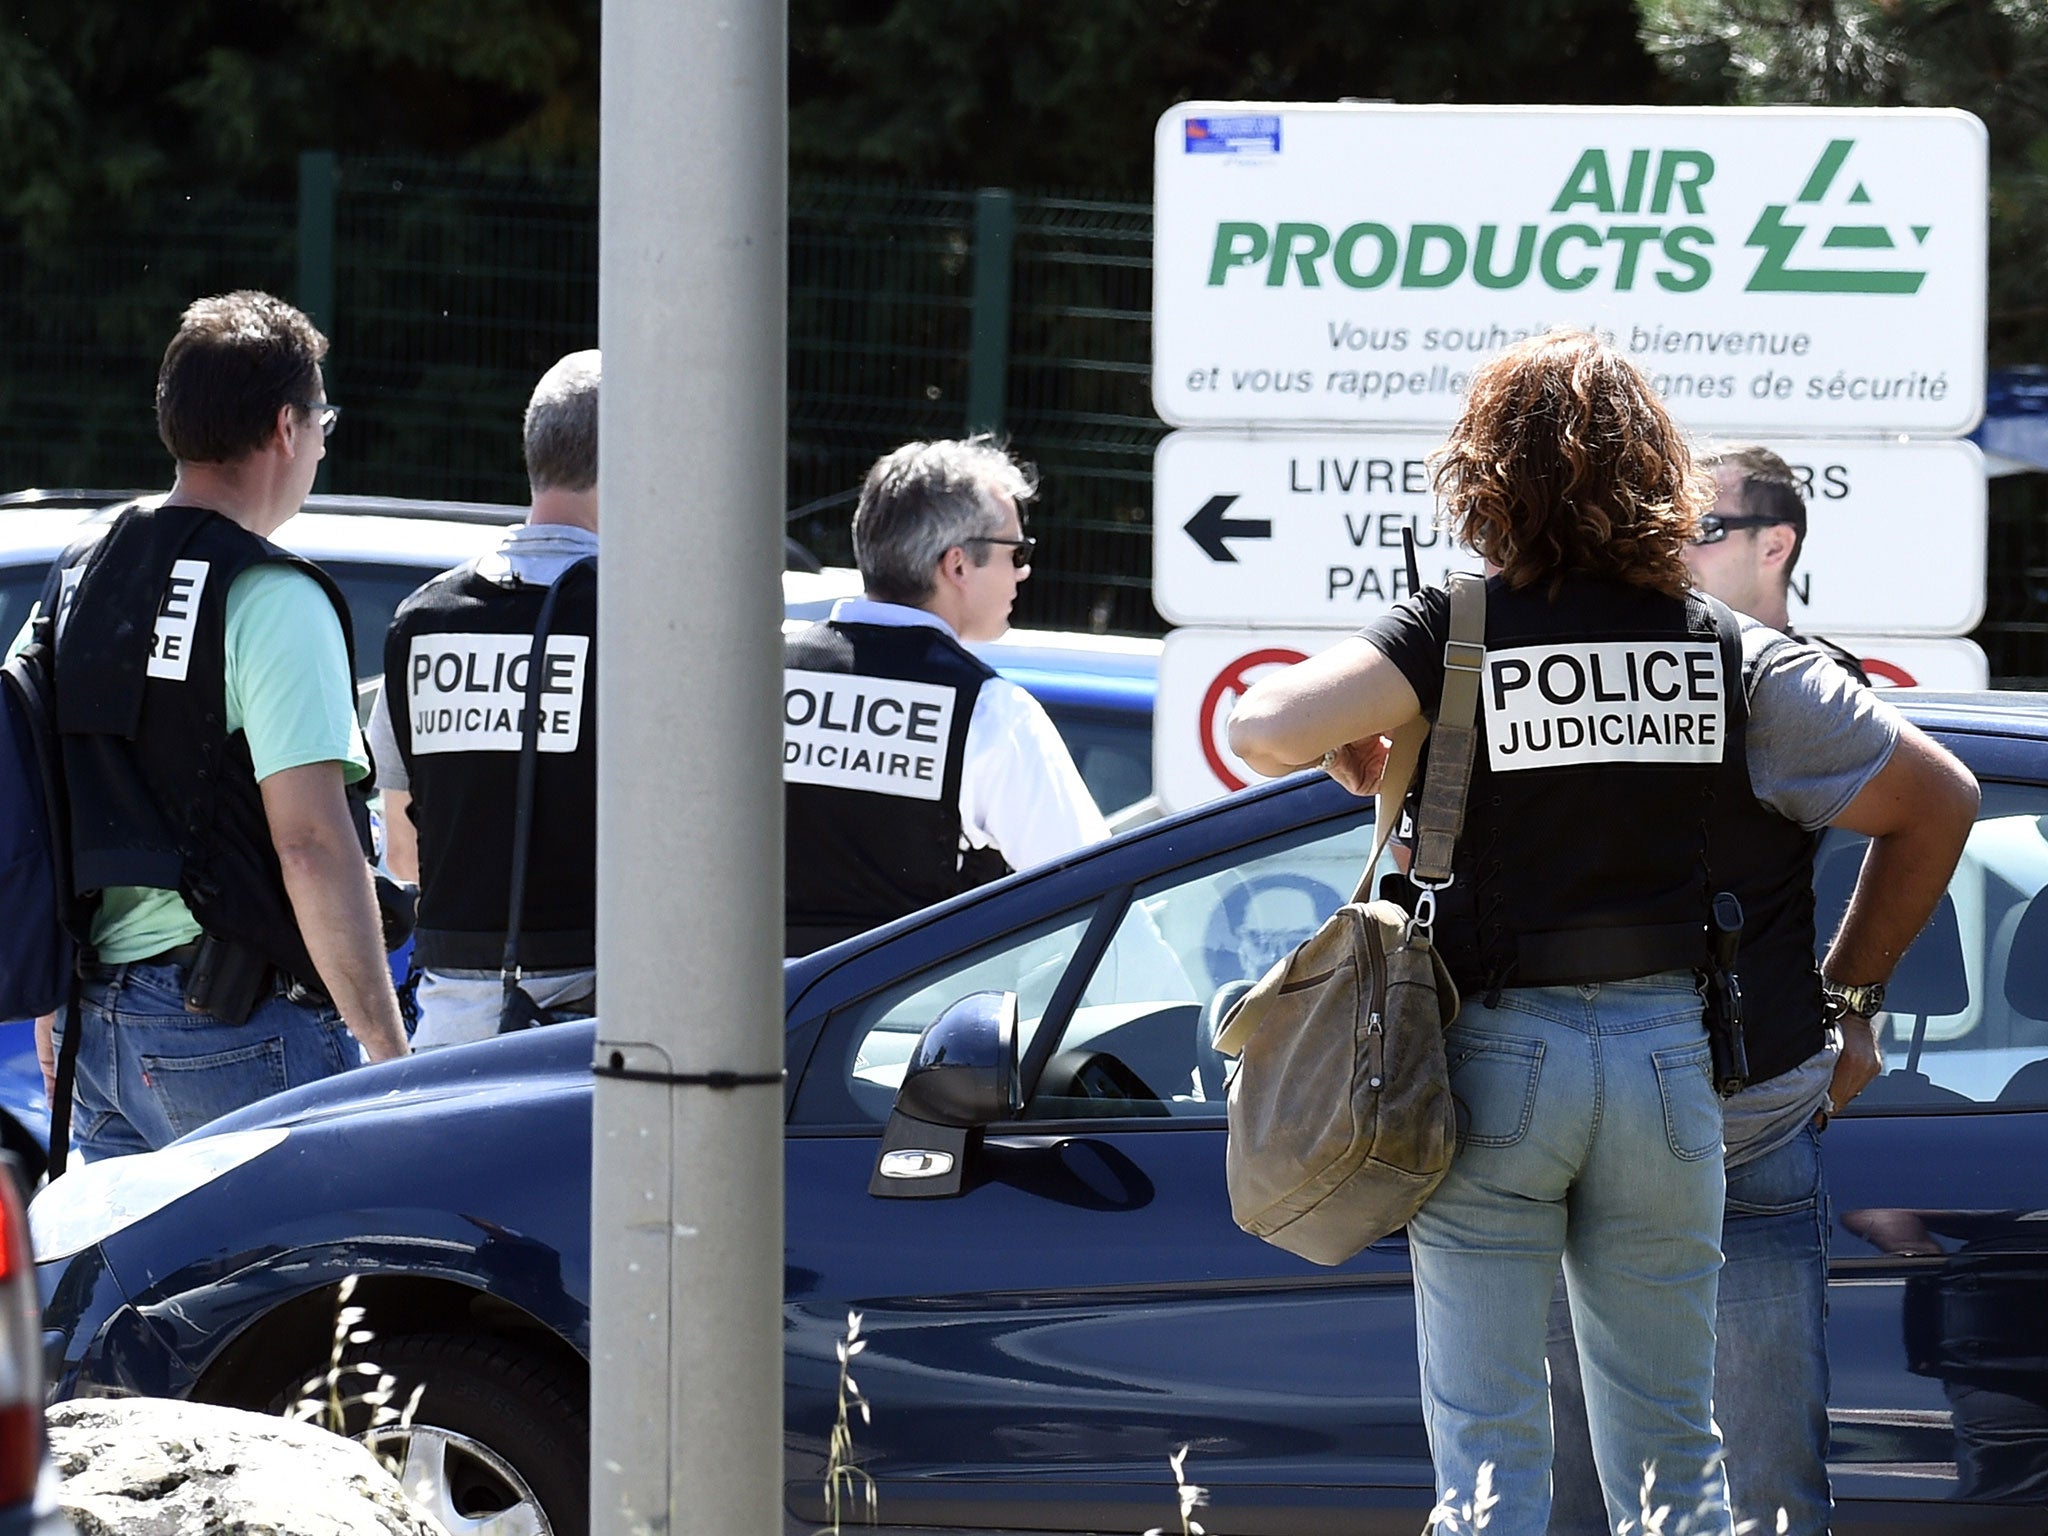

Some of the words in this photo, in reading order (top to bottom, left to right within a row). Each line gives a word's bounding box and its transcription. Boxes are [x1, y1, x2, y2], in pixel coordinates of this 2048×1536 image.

[1550, 149, 1715, 214] AIR
[1207, 222, 1715, 293] PRODUCTS
[1327, 320, 1409, 351] Vous
[1630, 325, 1811, 356] bienvenue
[1185, 366, 1219, 393] et
[1231, 369, 1313, 393] vous
[1751, 369, 1793, 400] de
[1806, 369, 1949, 401] sécurité
[1291, 459, 1428, 493] LIVRE
[413, 652, 576, 696] POLICE
[1490, 650, 1719, 711] POLICE
[415, 708, 571, 735] JUDICIAIRE
[784, 688, 942, 743] OLICE
[1499, 713, 1717, 755] JUDICIAIRE
[784, 741, 935, 781] DICIAIRE
